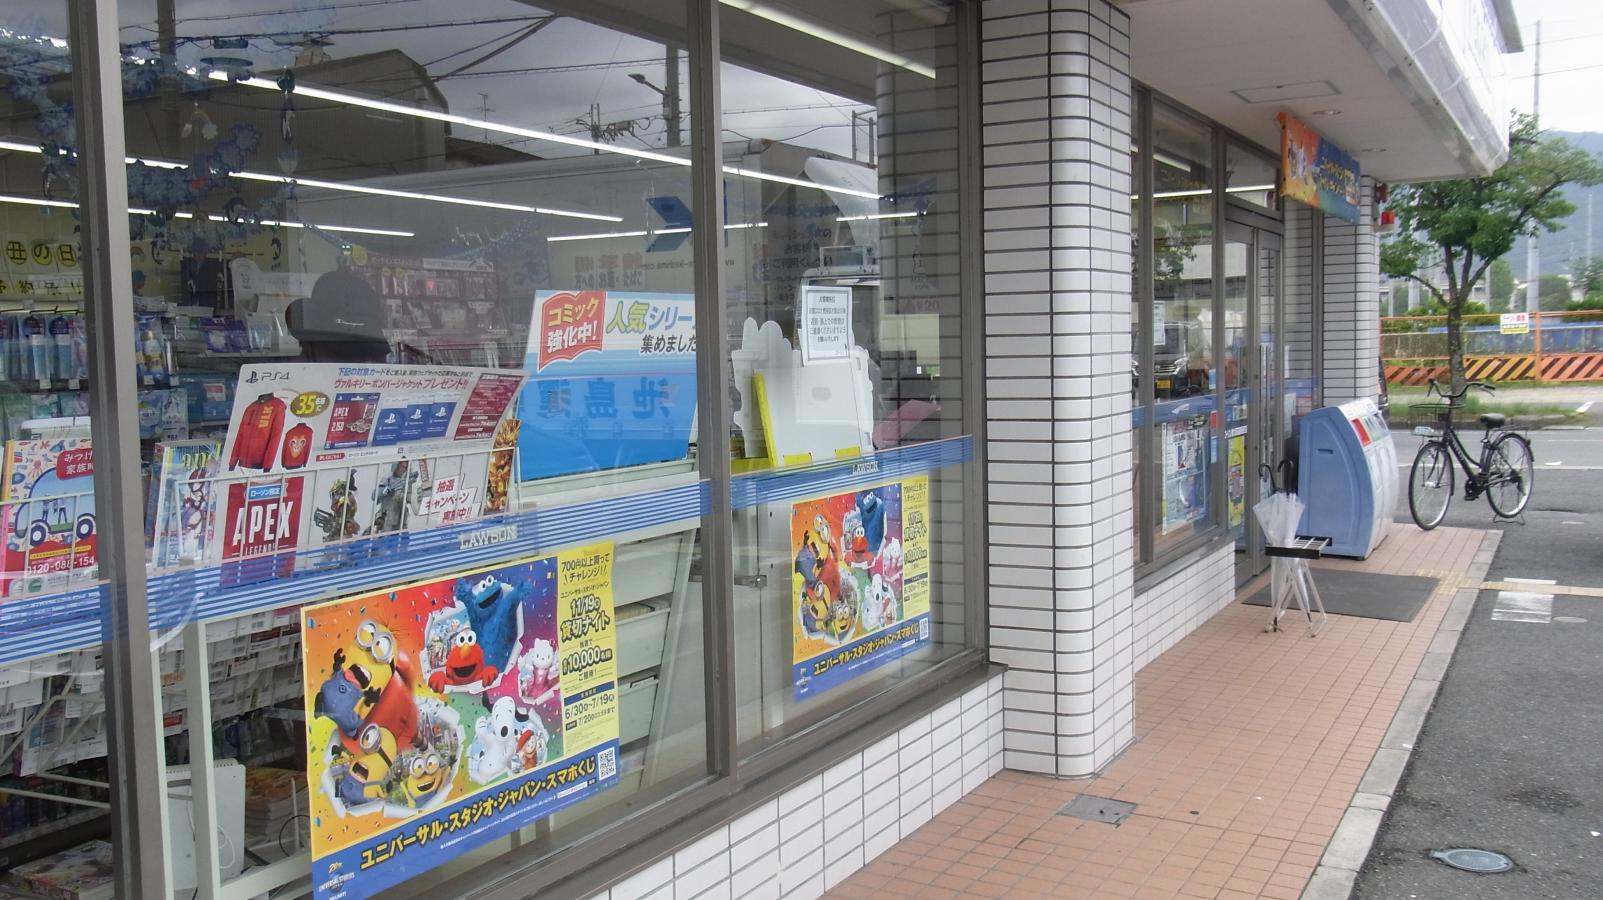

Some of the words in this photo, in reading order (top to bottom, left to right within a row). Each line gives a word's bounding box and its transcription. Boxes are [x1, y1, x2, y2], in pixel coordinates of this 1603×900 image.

[548, 298, 600, 327] コミック
[606, 301, 696, 333] 人気シリー
[547, 326, 598, 352] 強化中!
[641, 333, 696, 354] 集めました
[261, 371, 290, 381] PS4
[425, 492, 470, 510] キャンペーン
[232, 501, 293, 546] APEX
[460, 524, 517, 549] LAWSON
[243, 543, 278, 556] LEGEND
[27, 556, 95, 575] 0120-088-154
[561, 552, 610, 573] 700円以上買って
[560, 611, 610, 643] 貸切ナイト
[360, 756, 597, 870] ユニバーサル・スタジオ・ジャパン・スマホくじ
